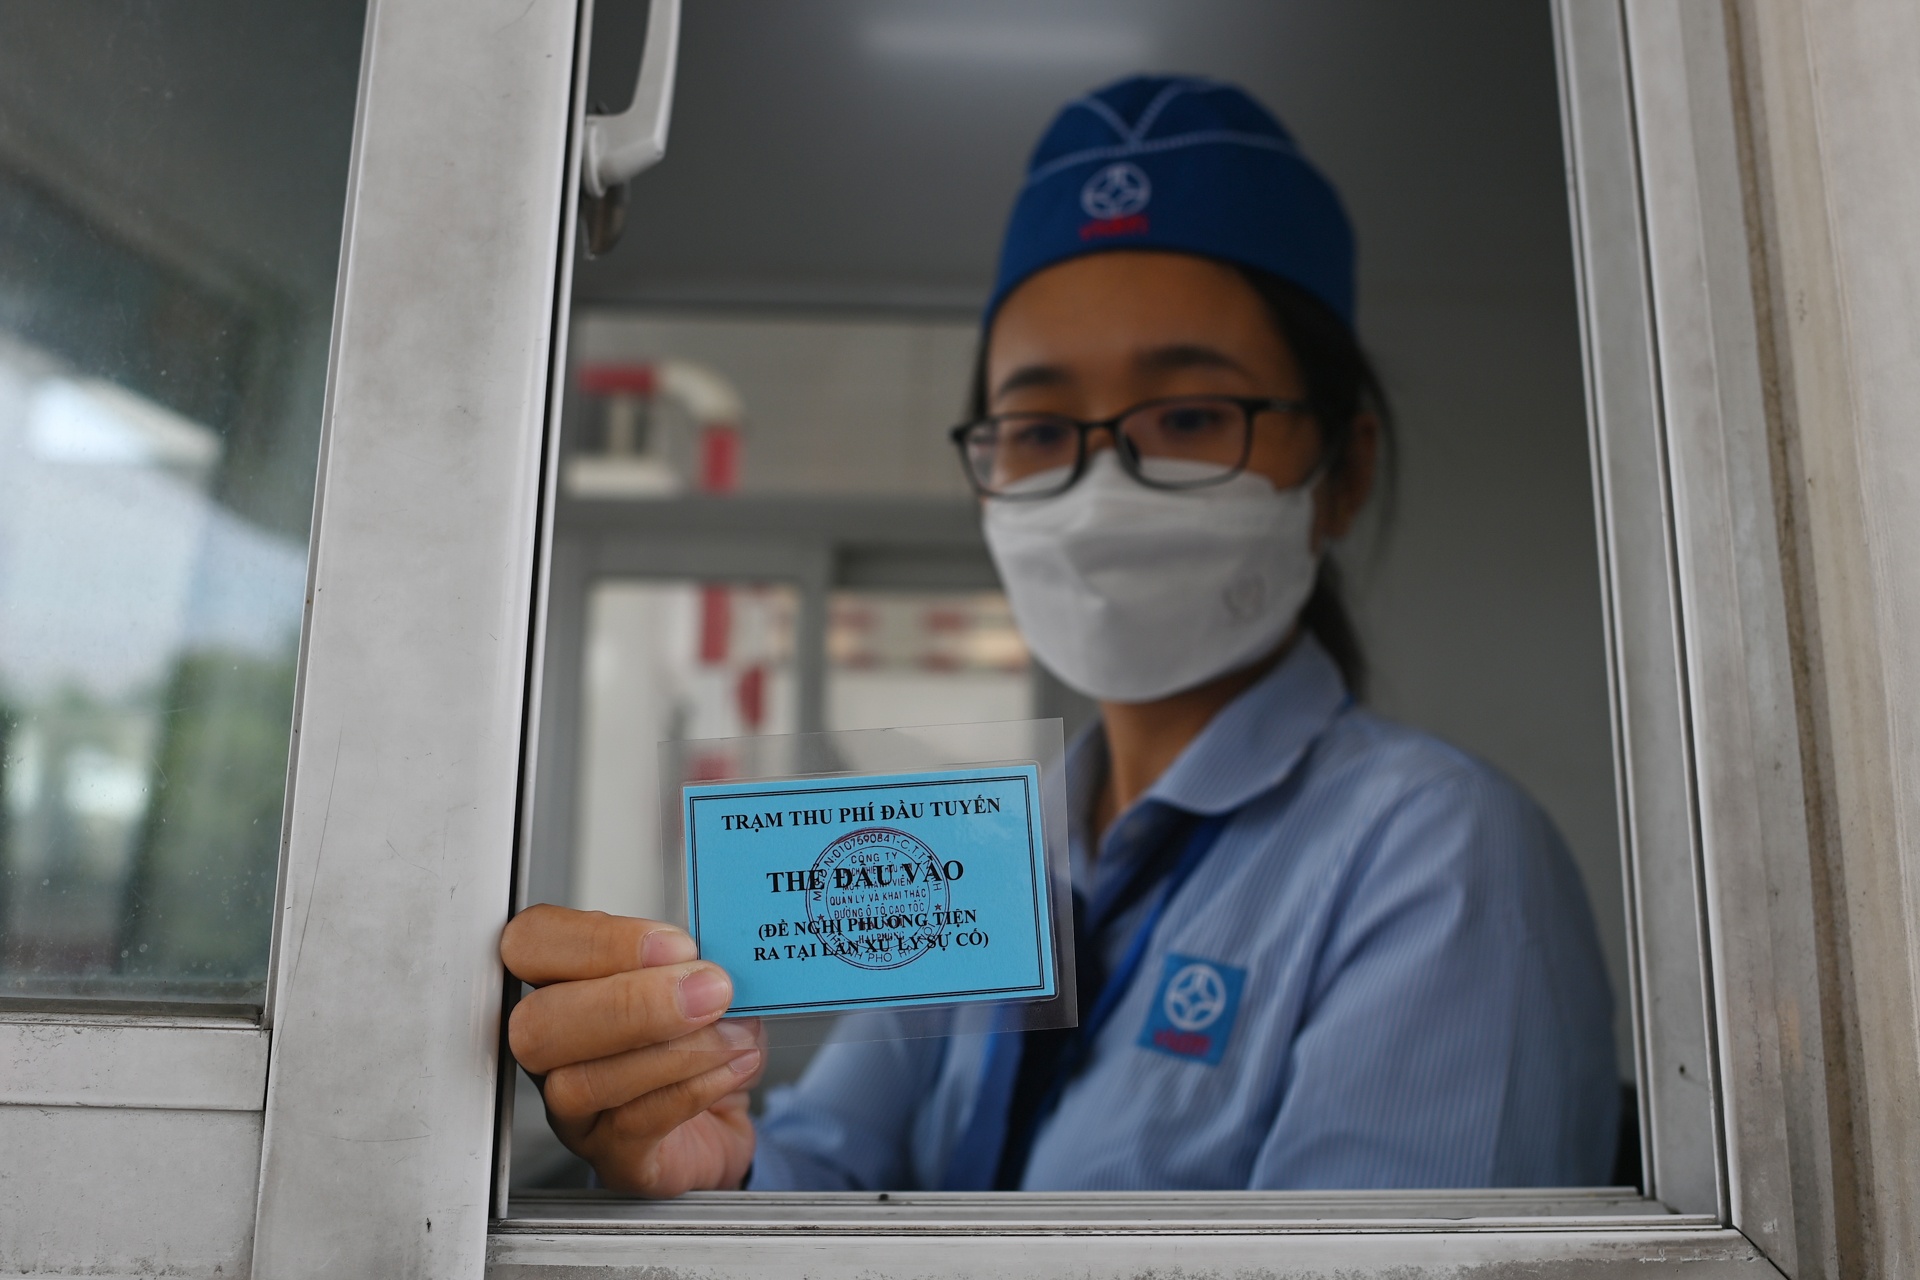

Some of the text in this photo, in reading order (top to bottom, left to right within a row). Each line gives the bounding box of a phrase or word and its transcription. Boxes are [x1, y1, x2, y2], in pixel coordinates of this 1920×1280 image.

[721, 794, 1001, 833] TRẠM THU PHÍ ĐẦU TUYẾN
[851, 851, 898, 864] CÔNG TY
[901, 855, 964, 884] VÀO
[882, 889, 902, 901] KHAI
[904, 886, 927, 900] THÁC
[889, 904, 905, 915] CAO
[758, 918, 789, 941] (ĐỀ
[794, 919, 843, 936] NGHỊ
[932, 908, 977, 928] TIỆN
[753, 946, 780, 961] RA
[783, 943, 817, 962] TẠI
[927, 931, 952, 951] SỰ
[955, 928, 989, 948] CỐ)
